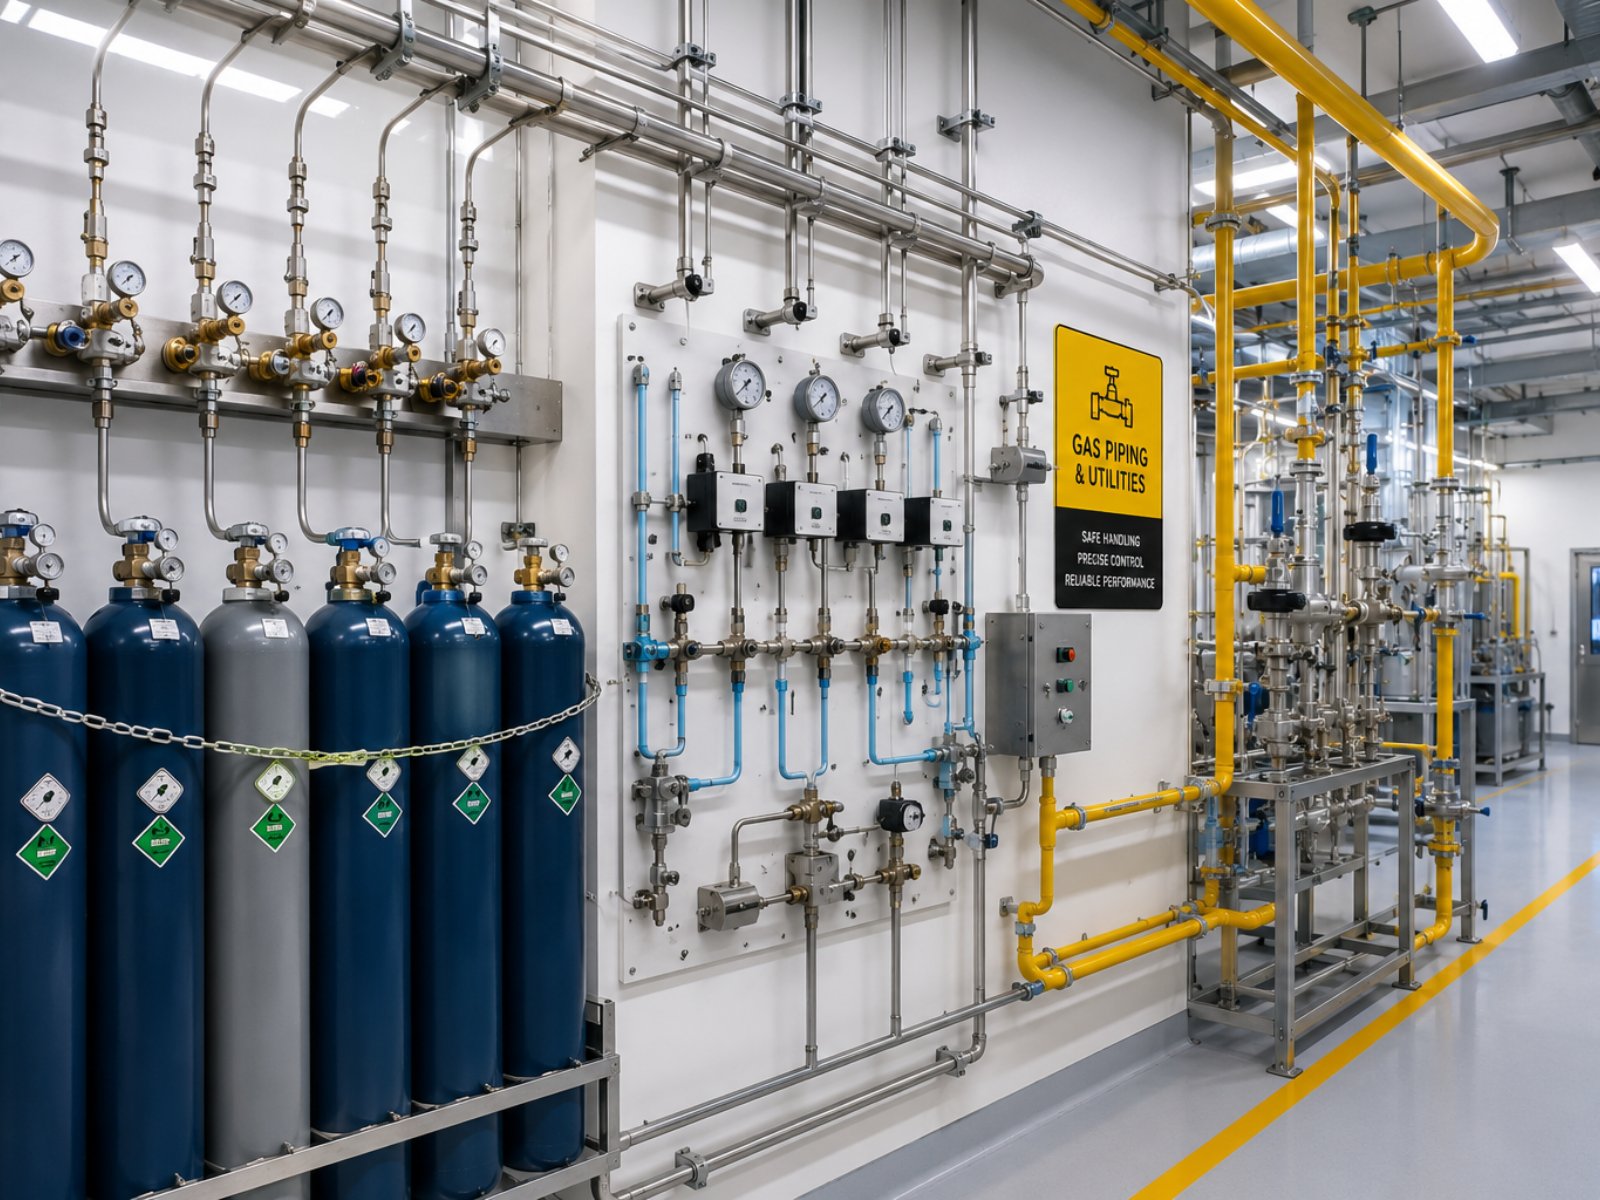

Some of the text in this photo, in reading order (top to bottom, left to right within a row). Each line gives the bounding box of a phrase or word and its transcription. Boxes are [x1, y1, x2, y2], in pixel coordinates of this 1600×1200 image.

[1072, 433, 1148, 467] GAS PIPING
[1075, 463, 1145, 493] & UTILITIES
[1081, 530, 1140, 547] SAFE HANDLING
[1077, 552, 1144, 568] PRECISE CONTROL
[1065, 573, 1155, 589] RELIABLE PERFORMANCE
